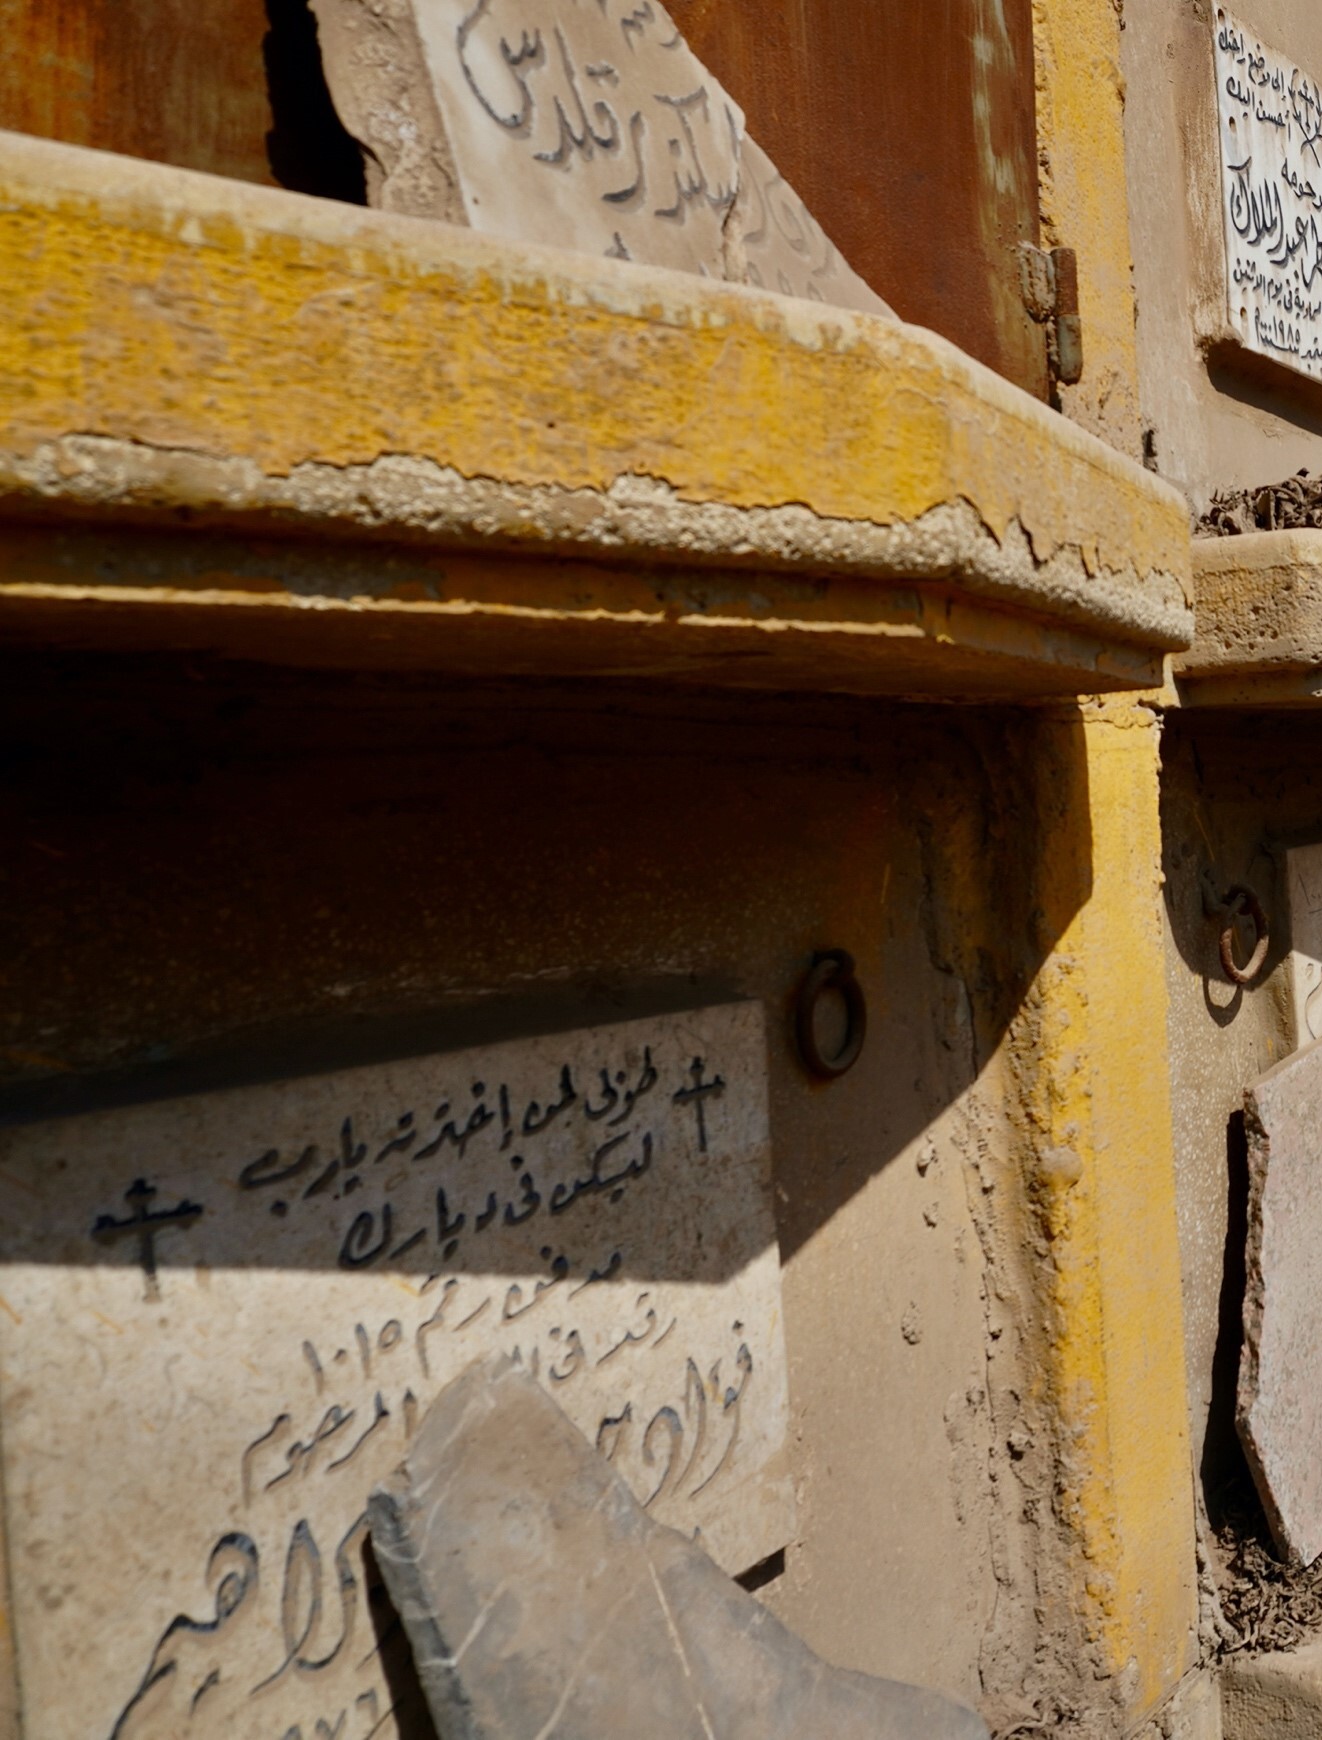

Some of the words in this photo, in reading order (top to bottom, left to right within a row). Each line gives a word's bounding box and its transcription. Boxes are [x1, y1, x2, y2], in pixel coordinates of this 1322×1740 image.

[1267, 279, 1284, 309] يوم
[302, 1318, 404, 1396] ١٠١٥
[416, 1274, 491, 1379] رقم
[242, 1387, 419, 1507] المرحوم
